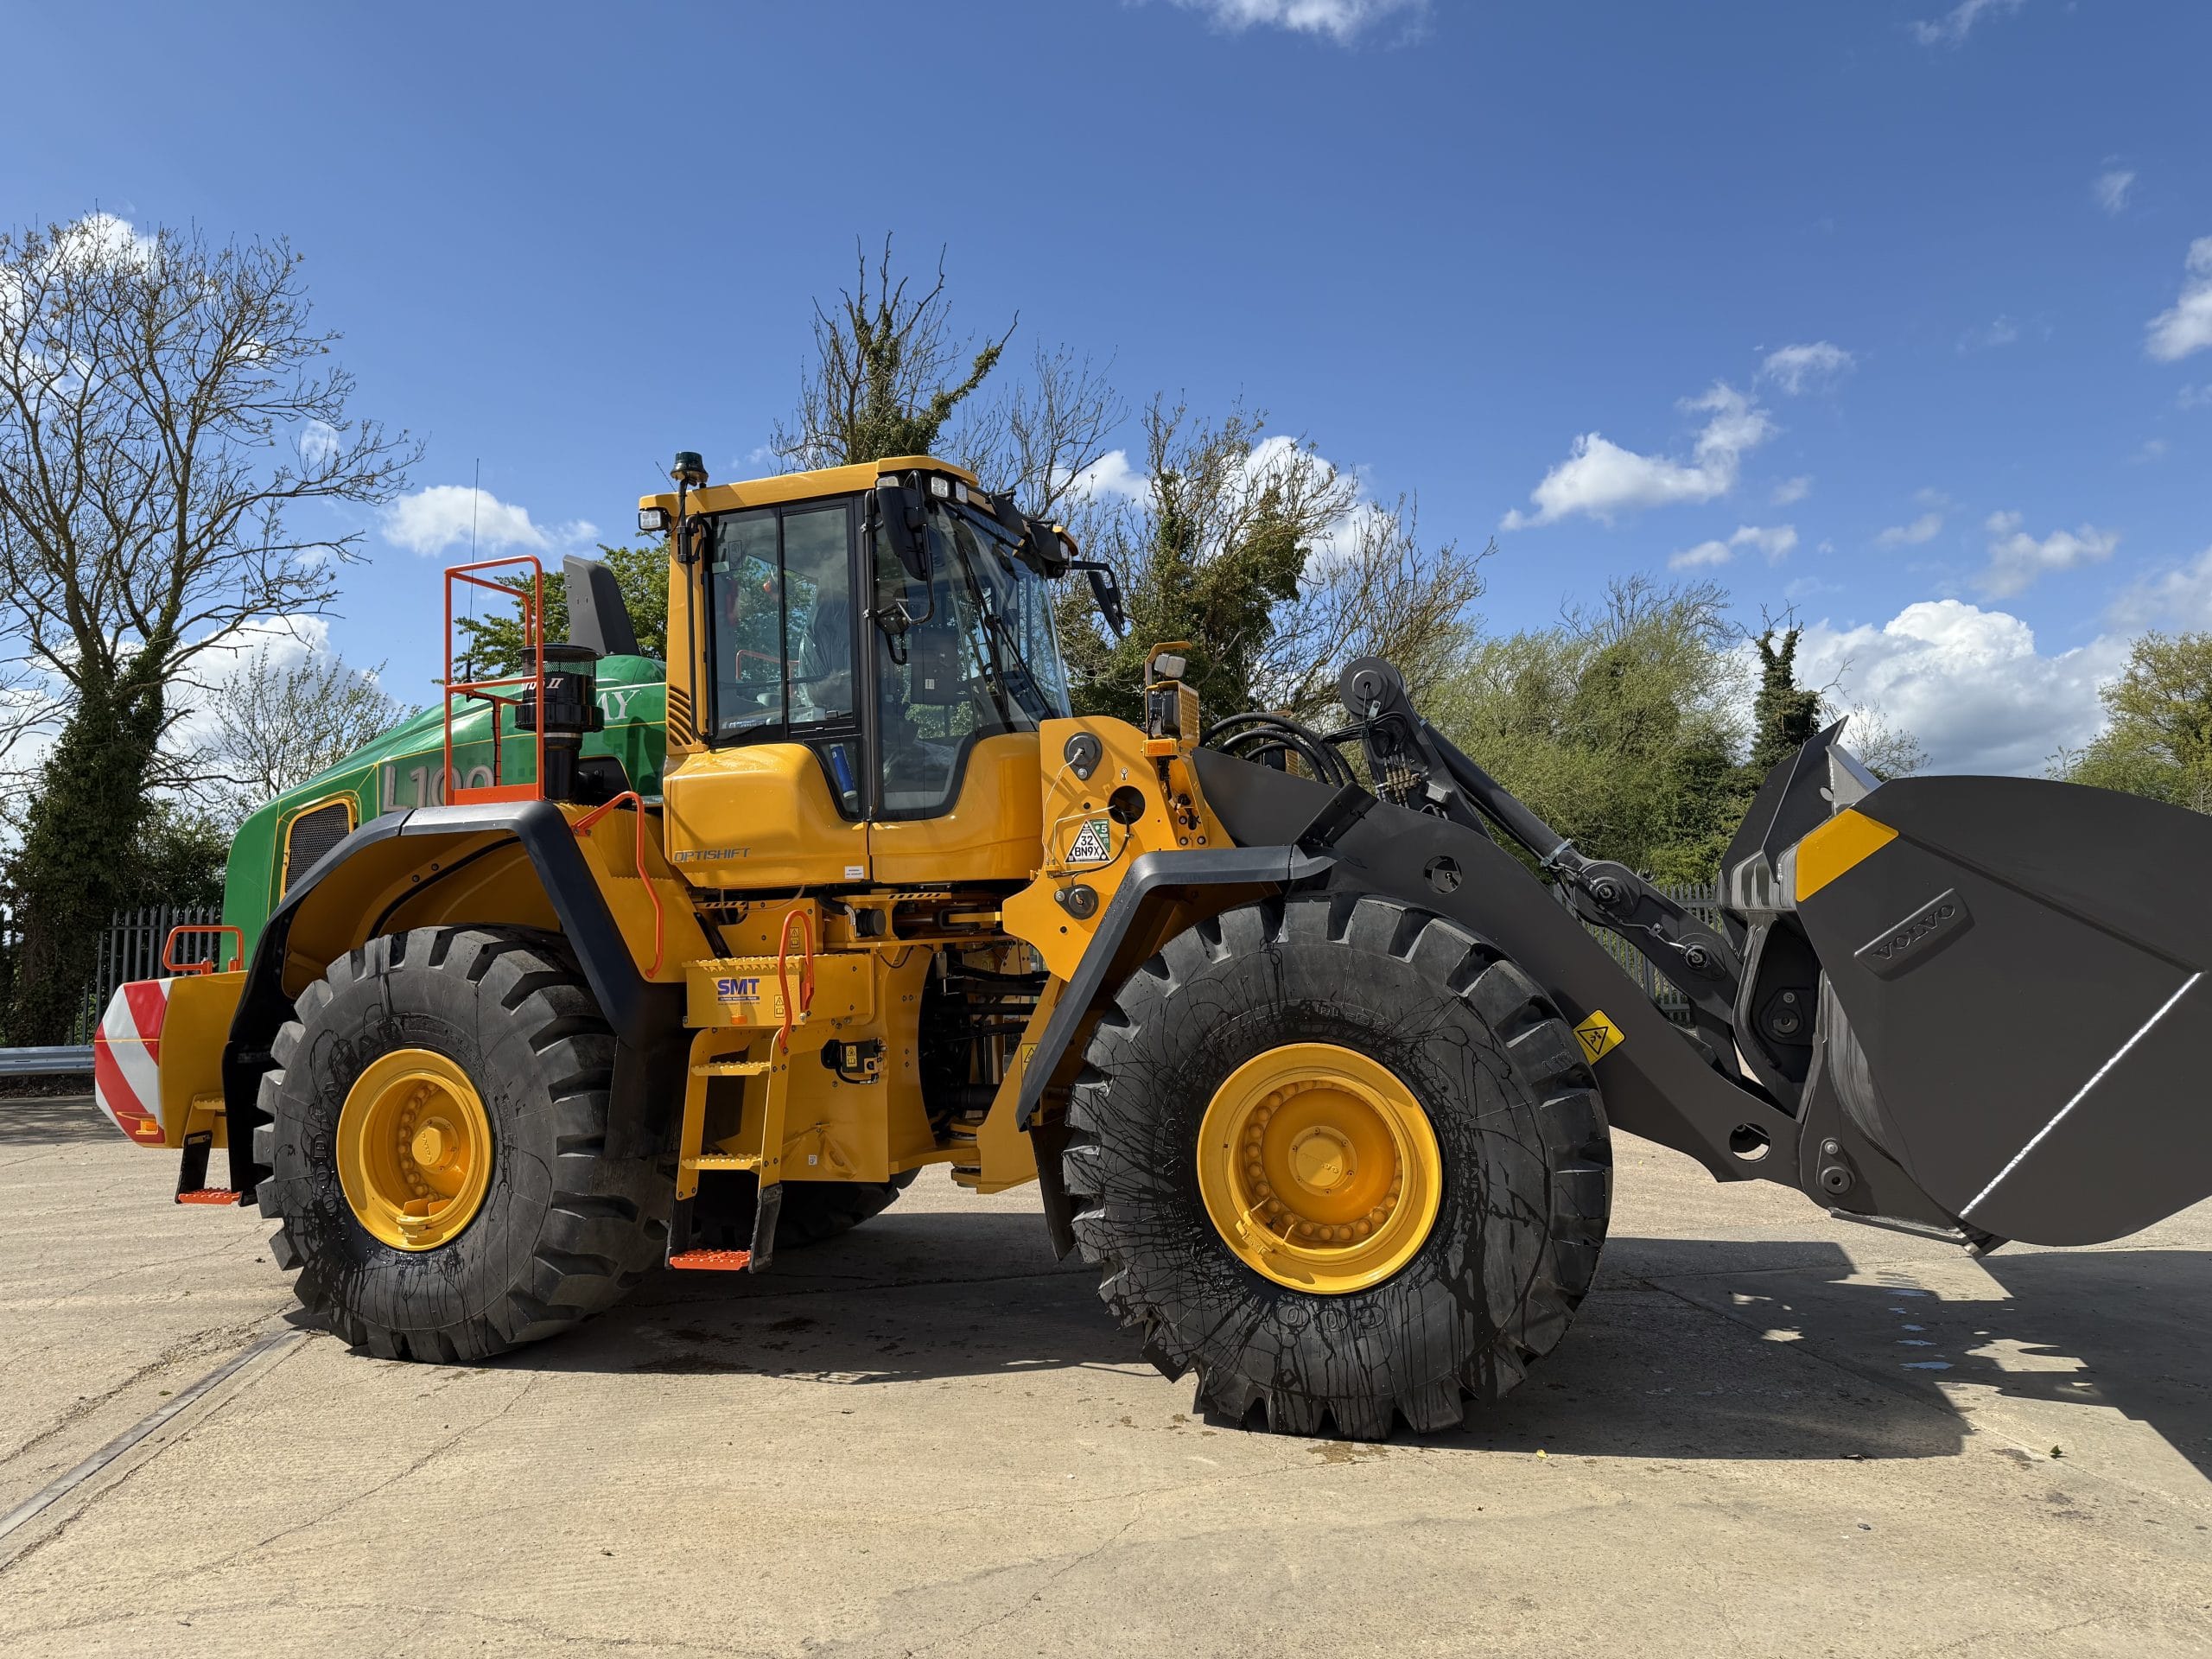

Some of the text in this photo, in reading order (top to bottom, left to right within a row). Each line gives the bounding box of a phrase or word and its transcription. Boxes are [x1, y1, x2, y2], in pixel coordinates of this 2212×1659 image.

[1081, 836, 1093, 846] 32
[674, 848, 751, 861] OPTISHIFT
[1872, 904, 1956, 960] VOLVO
[717, 978, 760, 995] SMT
